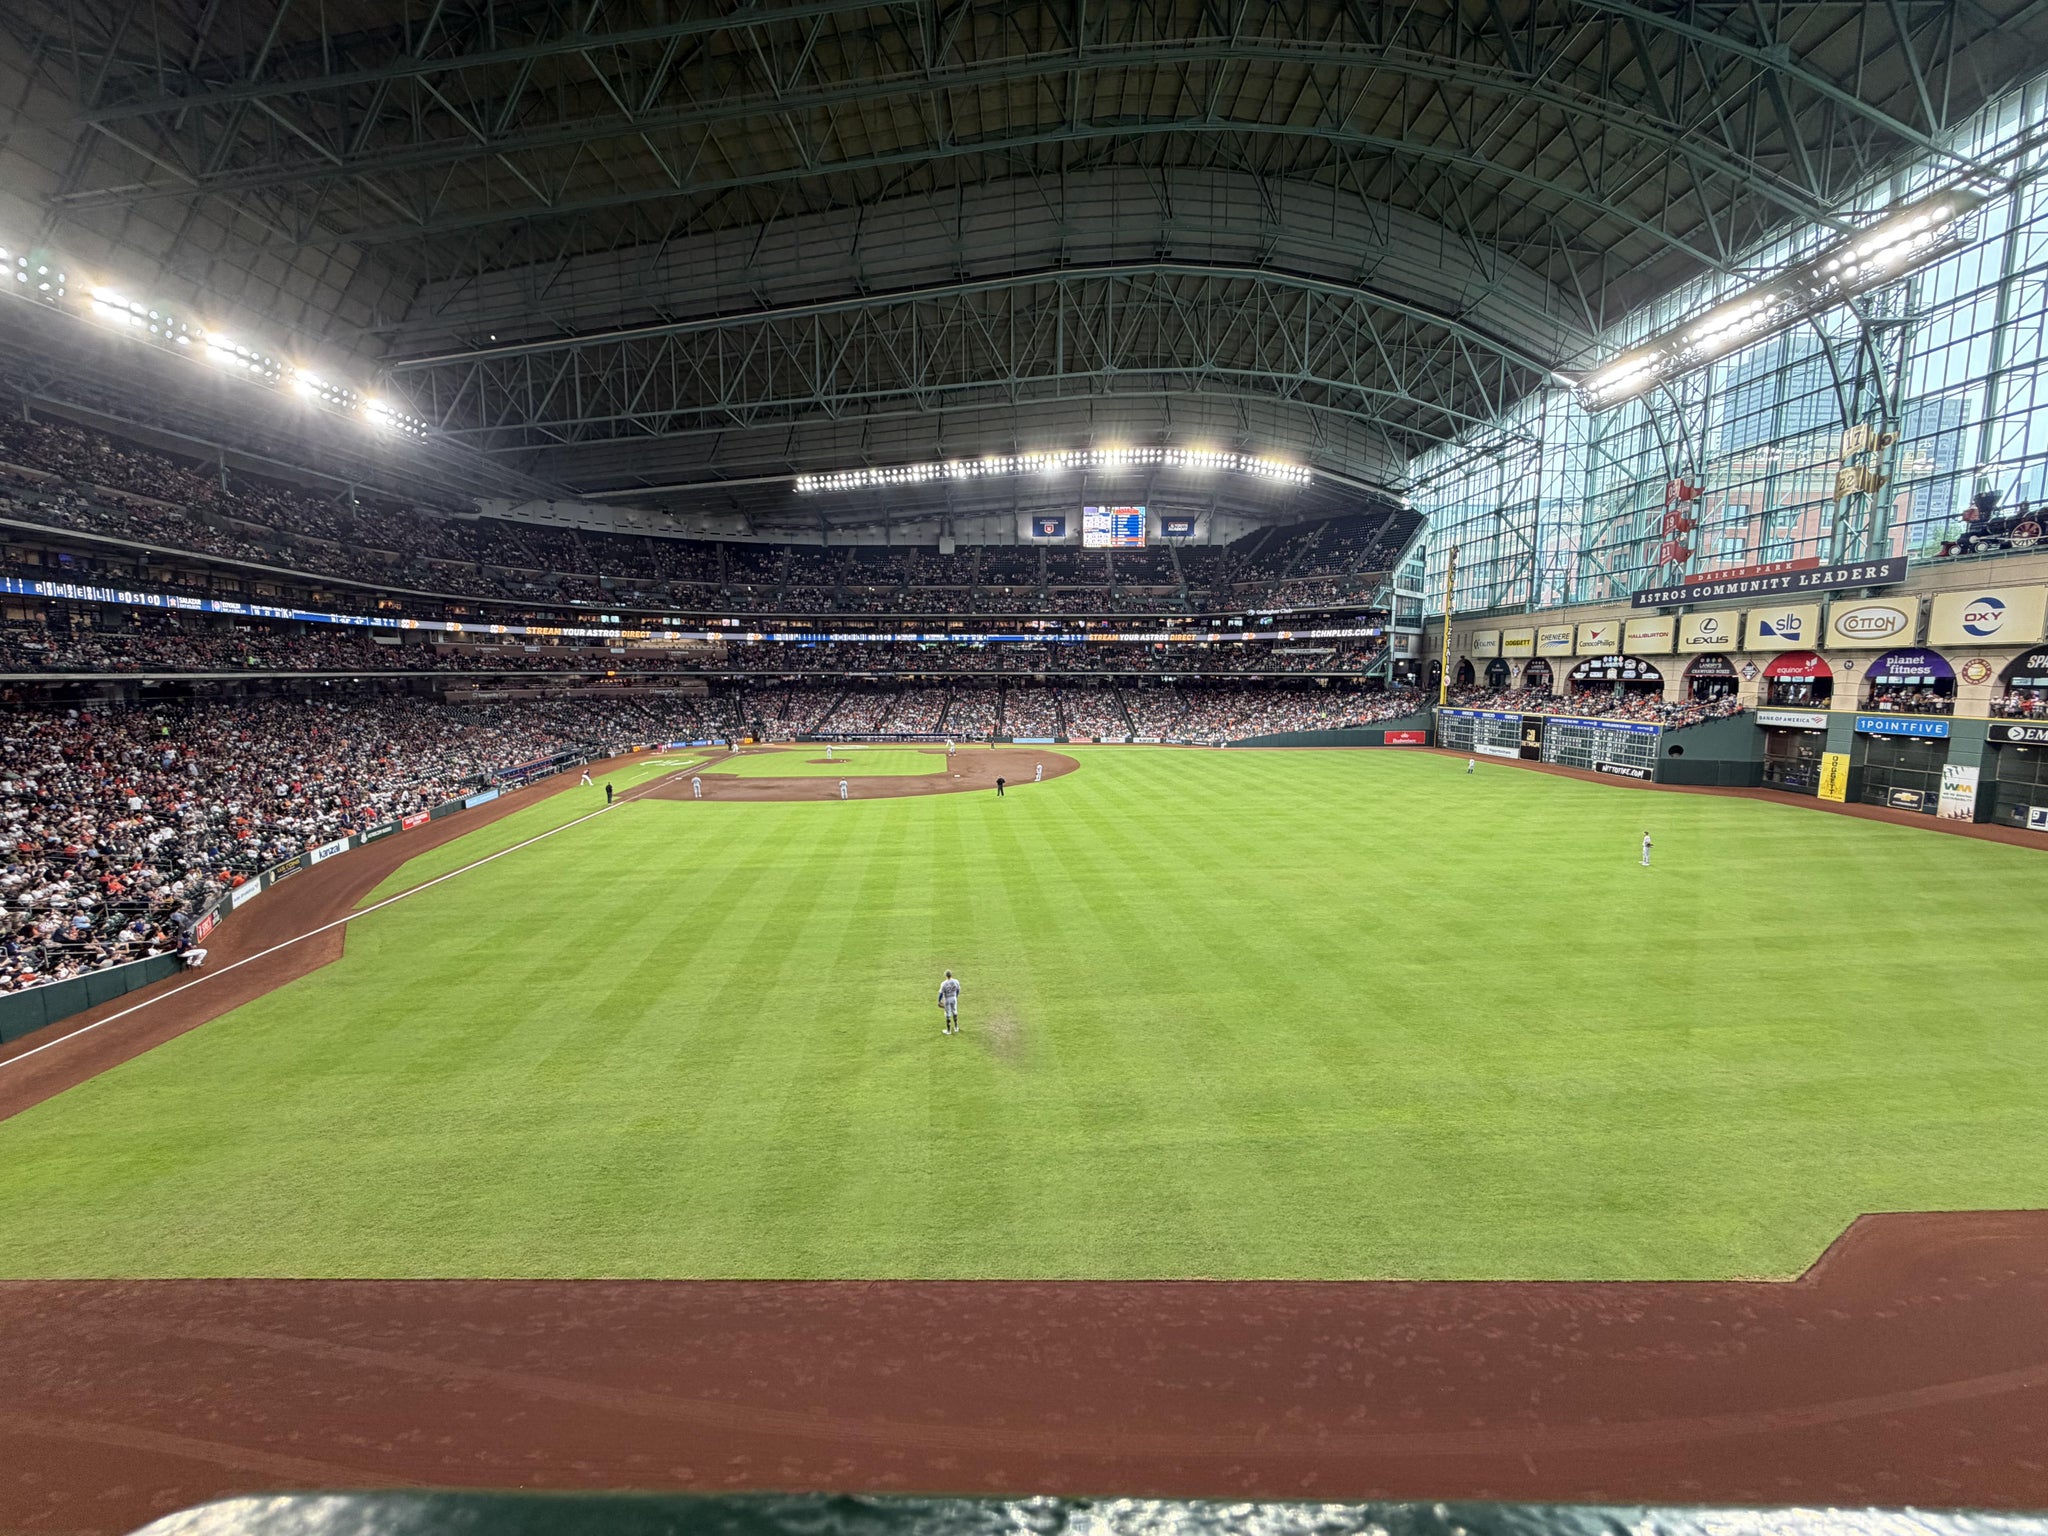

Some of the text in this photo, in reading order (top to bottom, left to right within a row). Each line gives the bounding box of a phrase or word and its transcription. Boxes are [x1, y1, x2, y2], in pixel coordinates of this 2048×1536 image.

[1847, 431, 1861, 450] 17
[1839, 474, 1854, 491] 22
[1666, 515, 1675, 529] 19
[1662, 546, 1670, 558] 21
[1698, 562, 1793, 581] DAIKIN PARK
[1639, 564, 1890, 604] ASTROS COMMUNITY LEADERS
[1776, 613, 1802, 631] slb
[1965, 611, 2003, 622] OXY
[1843, 615, 1897, 633] COTTON
[525, 627, 651, 638] STREAM YOUR ASTROS DIRECT
[1541, 632, 1570, 641] CHENIERE
[1627, 631, 1669, 639] HALLIBURTON
[1579, 640, 1616, 648] ConocoPhillips
[1686, 636, 1729, 645] LEXUS
[1886, 655, 1925, 666] planet
[1776, 666, 1803, 675] equinor
[1889, 664, 1931, 674] fitness
[1861, 719, 1943, 734] 1POINTFIVE
[1829, 755, 1839, 795] DOGGETT
[1944, 782, 1973, 793] WM
